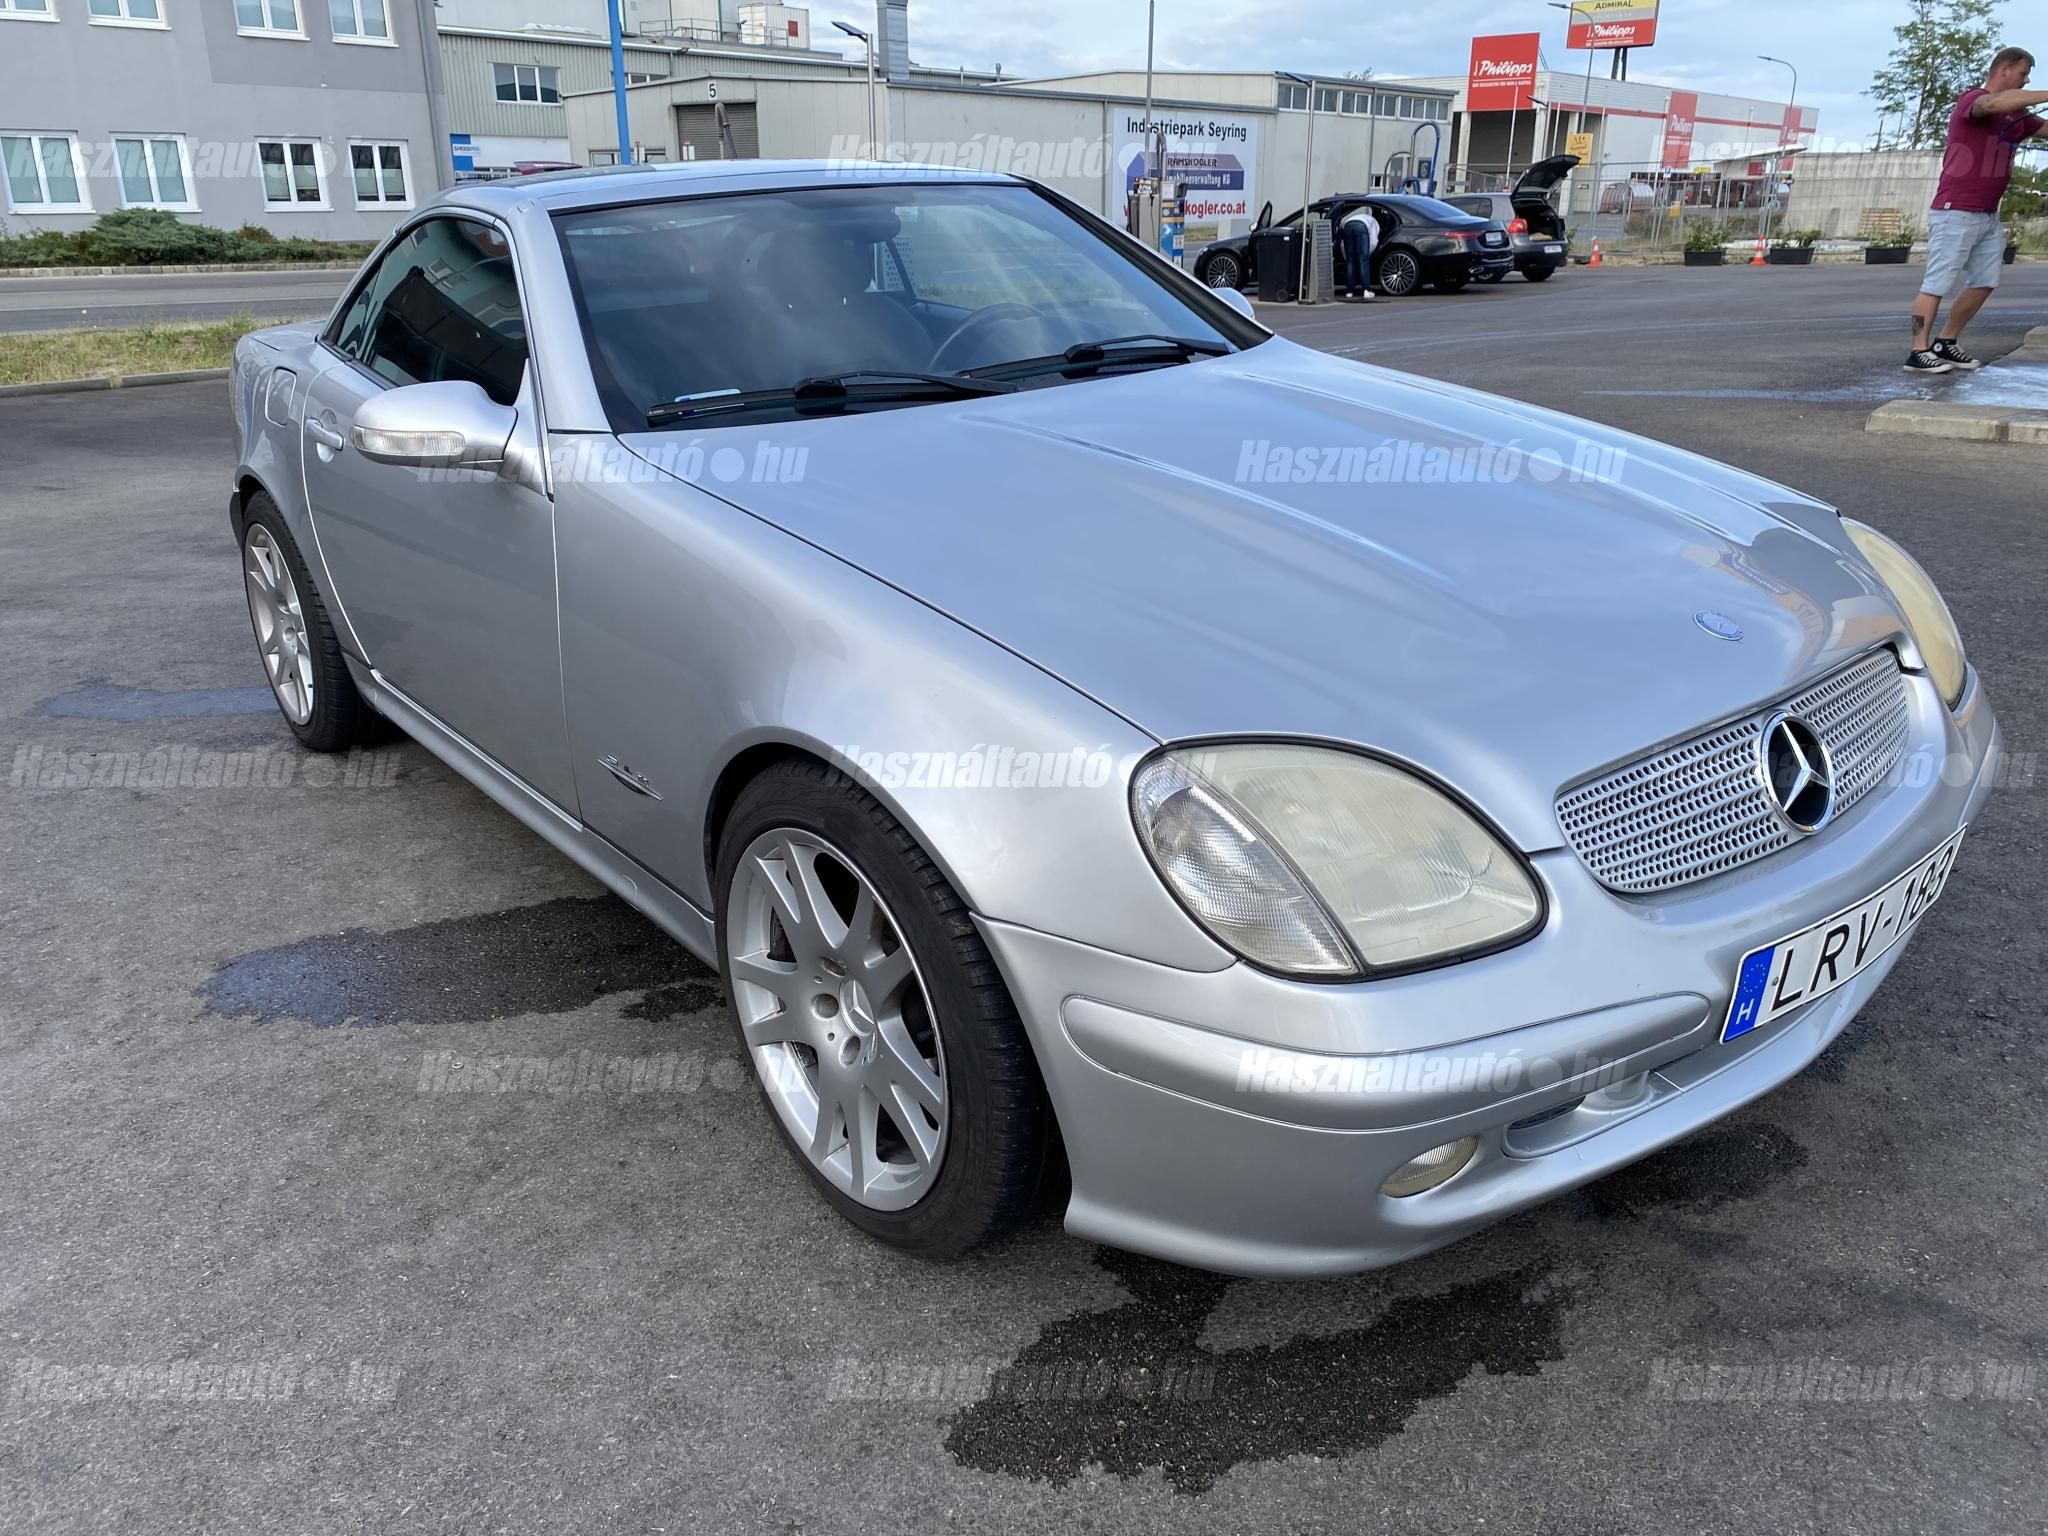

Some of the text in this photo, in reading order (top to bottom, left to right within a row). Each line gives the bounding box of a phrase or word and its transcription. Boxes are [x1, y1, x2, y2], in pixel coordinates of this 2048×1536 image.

[1594, 0, 1634, 10] ADMIRAL
[1591, 25, 1635, 38] Philipps
[1478, 60, 1533, 77] Philipps
[709, 83, 717, 98] 5
[1127, 117, 1247, 142] Indstriepark Seyring
[1167, 157, 1217, 168] RAMSKOGLER
[1222, 174, 1231, 185] KG
[1771, 844, 1954, 1012] LRV-183
[1735, 998, 1755, 1025] H
